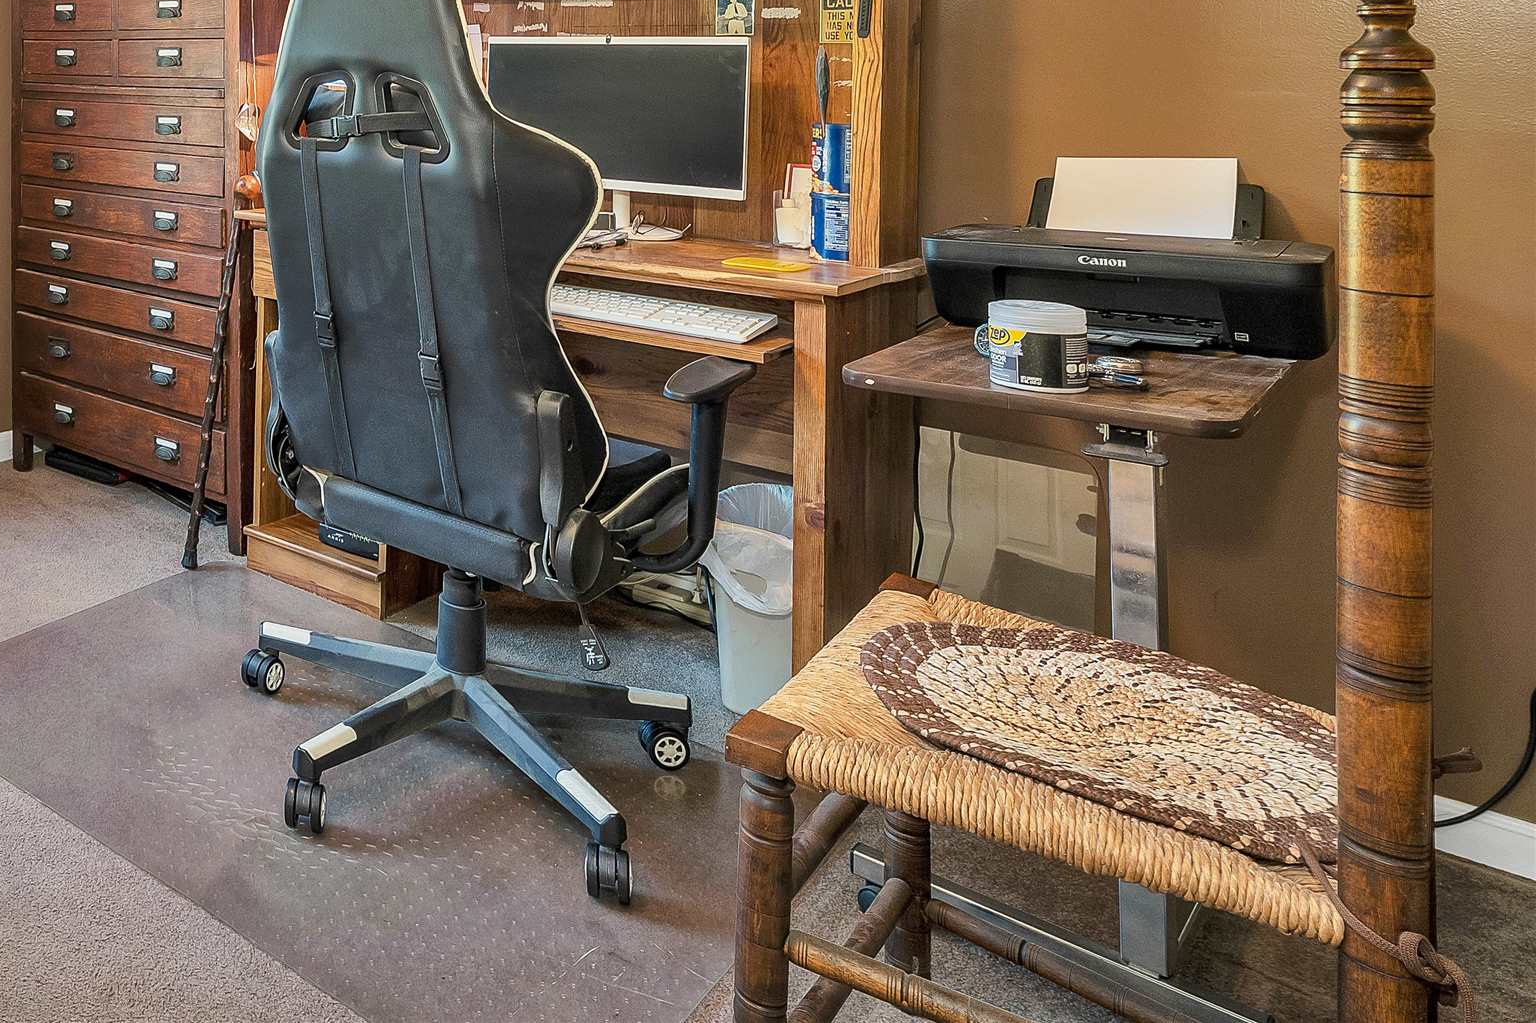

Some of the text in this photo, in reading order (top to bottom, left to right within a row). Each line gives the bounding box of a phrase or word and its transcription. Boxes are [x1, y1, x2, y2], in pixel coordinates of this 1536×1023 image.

[828, 11, 845, 21] THIS
[827, 21, 842, 30] HAS
[825, 31, 840, 41] USE
[1077, 255, 1127, 268] Canon
